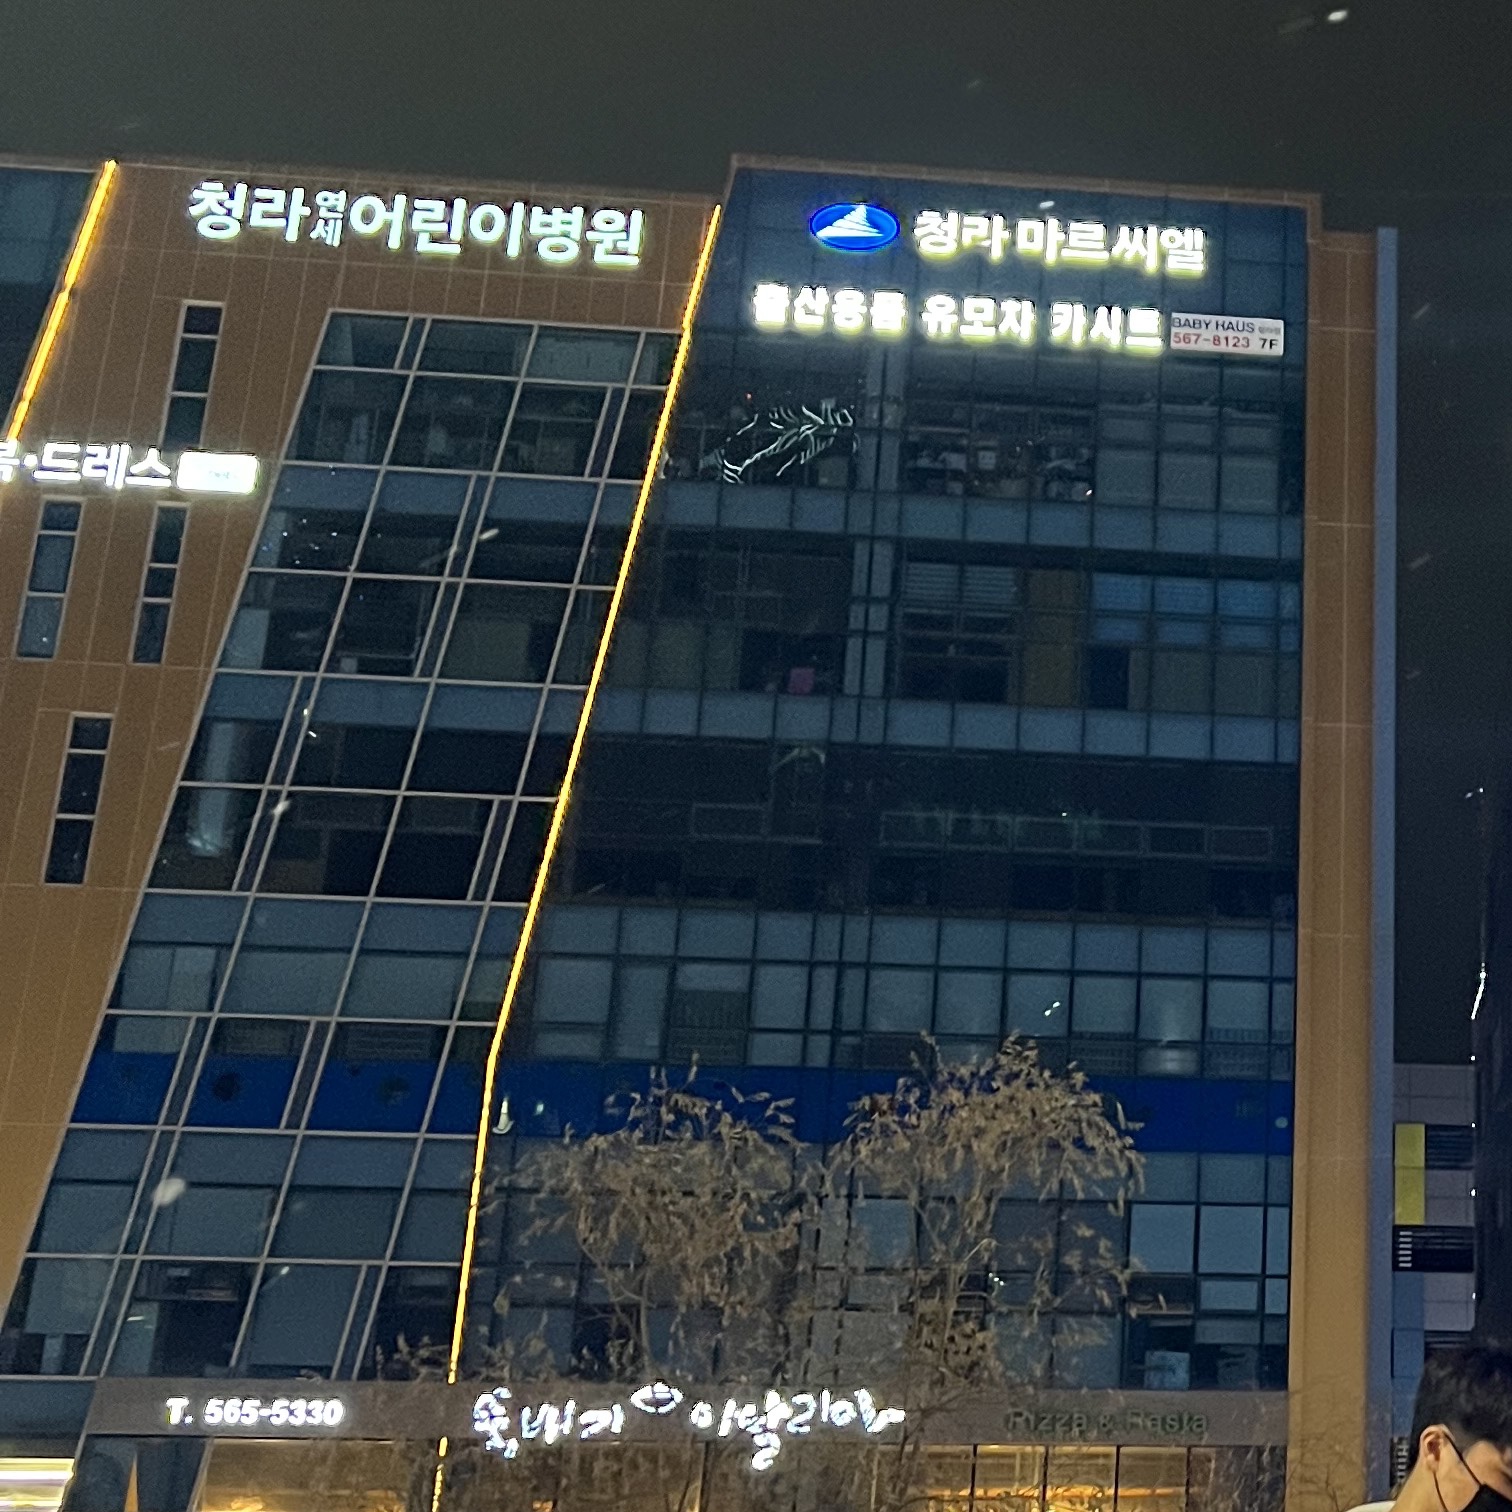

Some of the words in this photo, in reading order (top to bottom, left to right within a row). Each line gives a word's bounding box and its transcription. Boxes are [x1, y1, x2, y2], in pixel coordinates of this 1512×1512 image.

[921, 292, 1037, 344] 유모차
[1050, 299, 1164, 354] 카시트
[1171, 316, 1213, 330] BABY
[1215, 320, 1256, 334] HAUS
[1172, 331, 1251, 349] 567-8123
[1259, 337, 1280, 350] 7F
[203, 1398, 346, 1427] 565-5330
